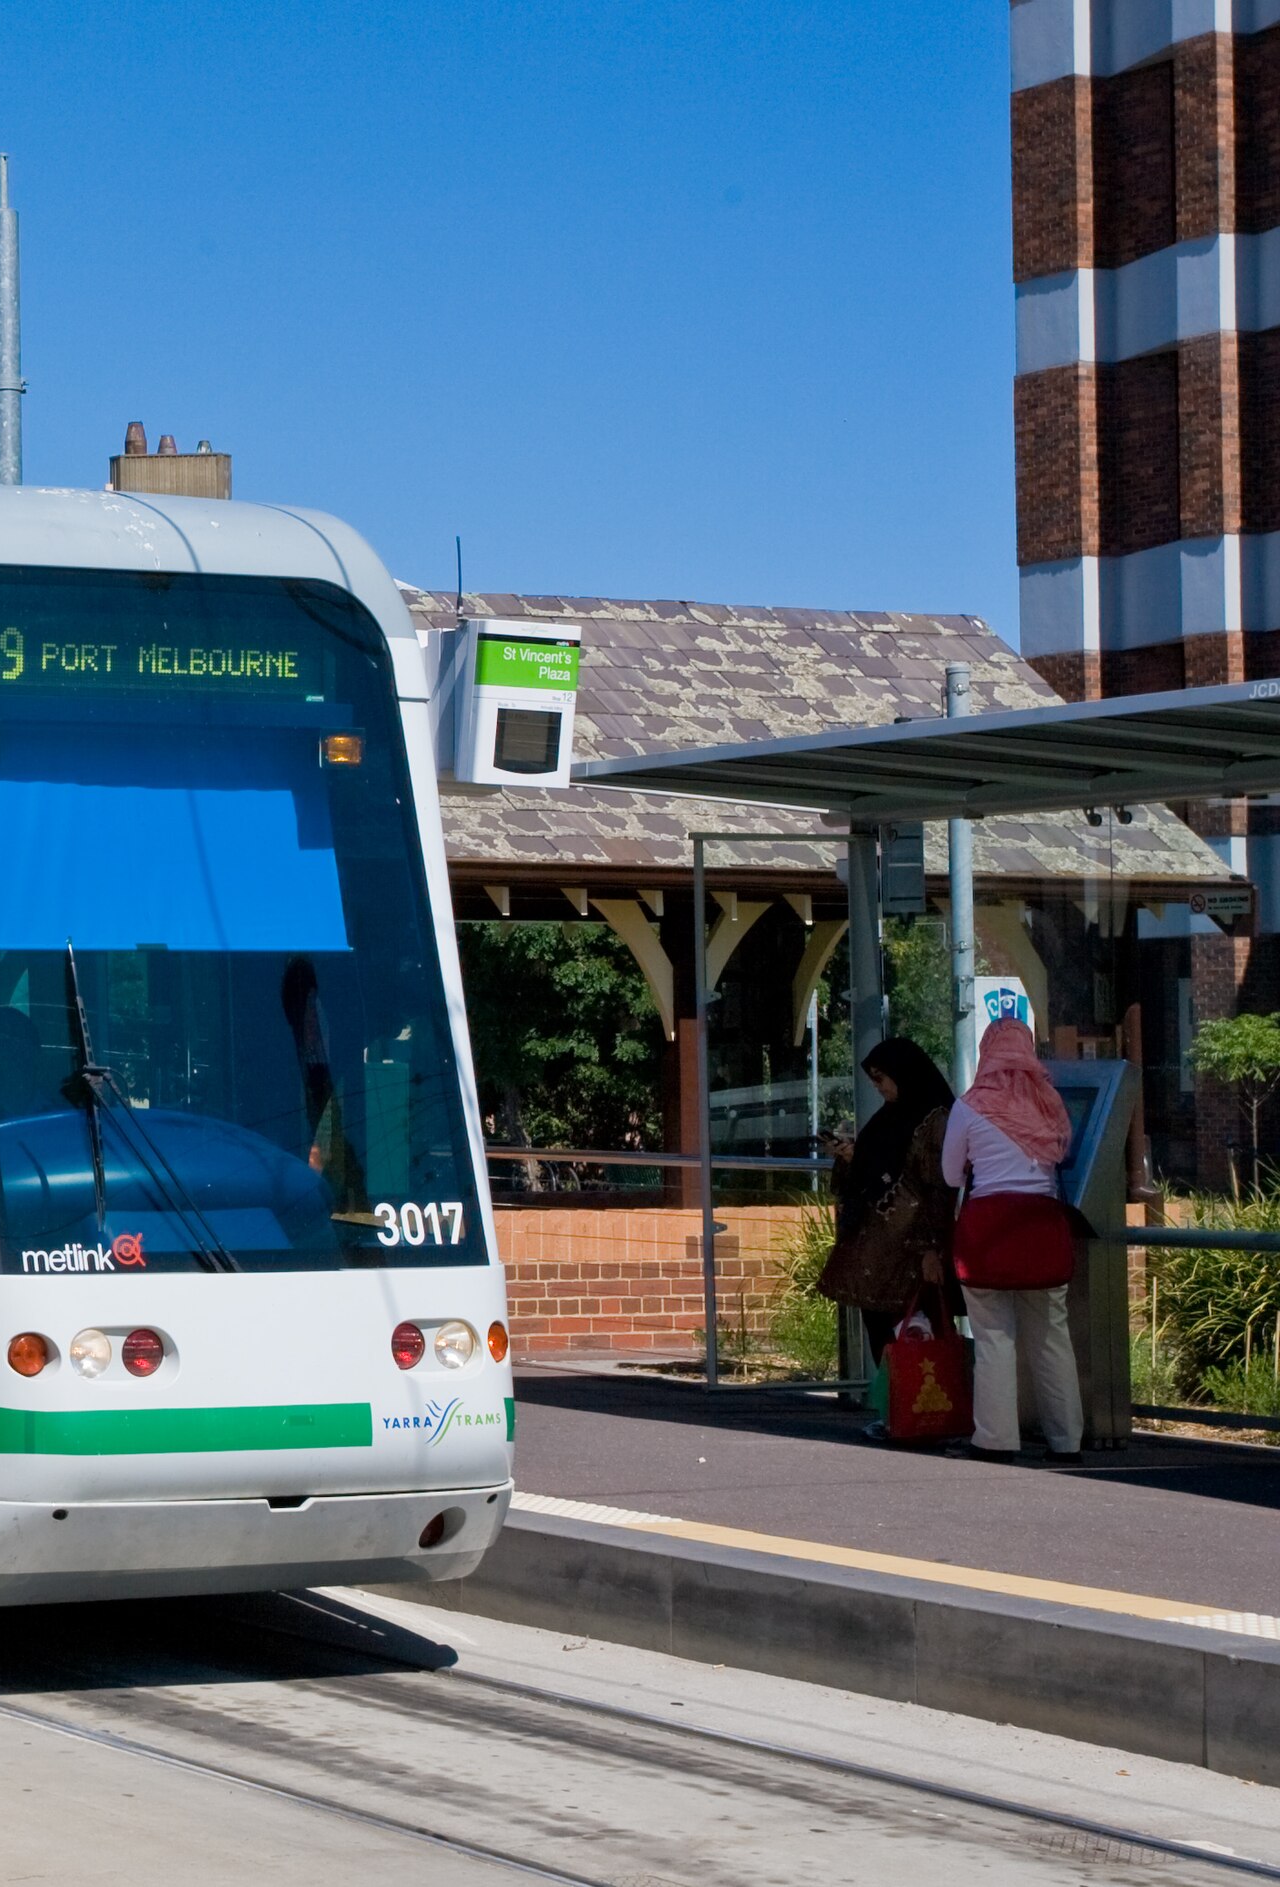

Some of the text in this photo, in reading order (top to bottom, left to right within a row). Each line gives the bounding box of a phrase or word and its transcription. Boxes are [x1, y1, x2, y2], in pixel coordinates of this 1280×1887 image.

[42, 642, 118, 672] PORT
[139, 643, 299, 679] MELBOURNE
[503, 646, 572, 665] St Vincent's
[538, 666, 571, 681] Plaza
[562, 692, 573, 703] 12
[1248, 682, 1280, 699] JCD
[374, 1202, 463, 1247] 3017
[21, 1243, 115, 1273] metlink
[383, 1413, 502, 1429] YARRA TRAMS
